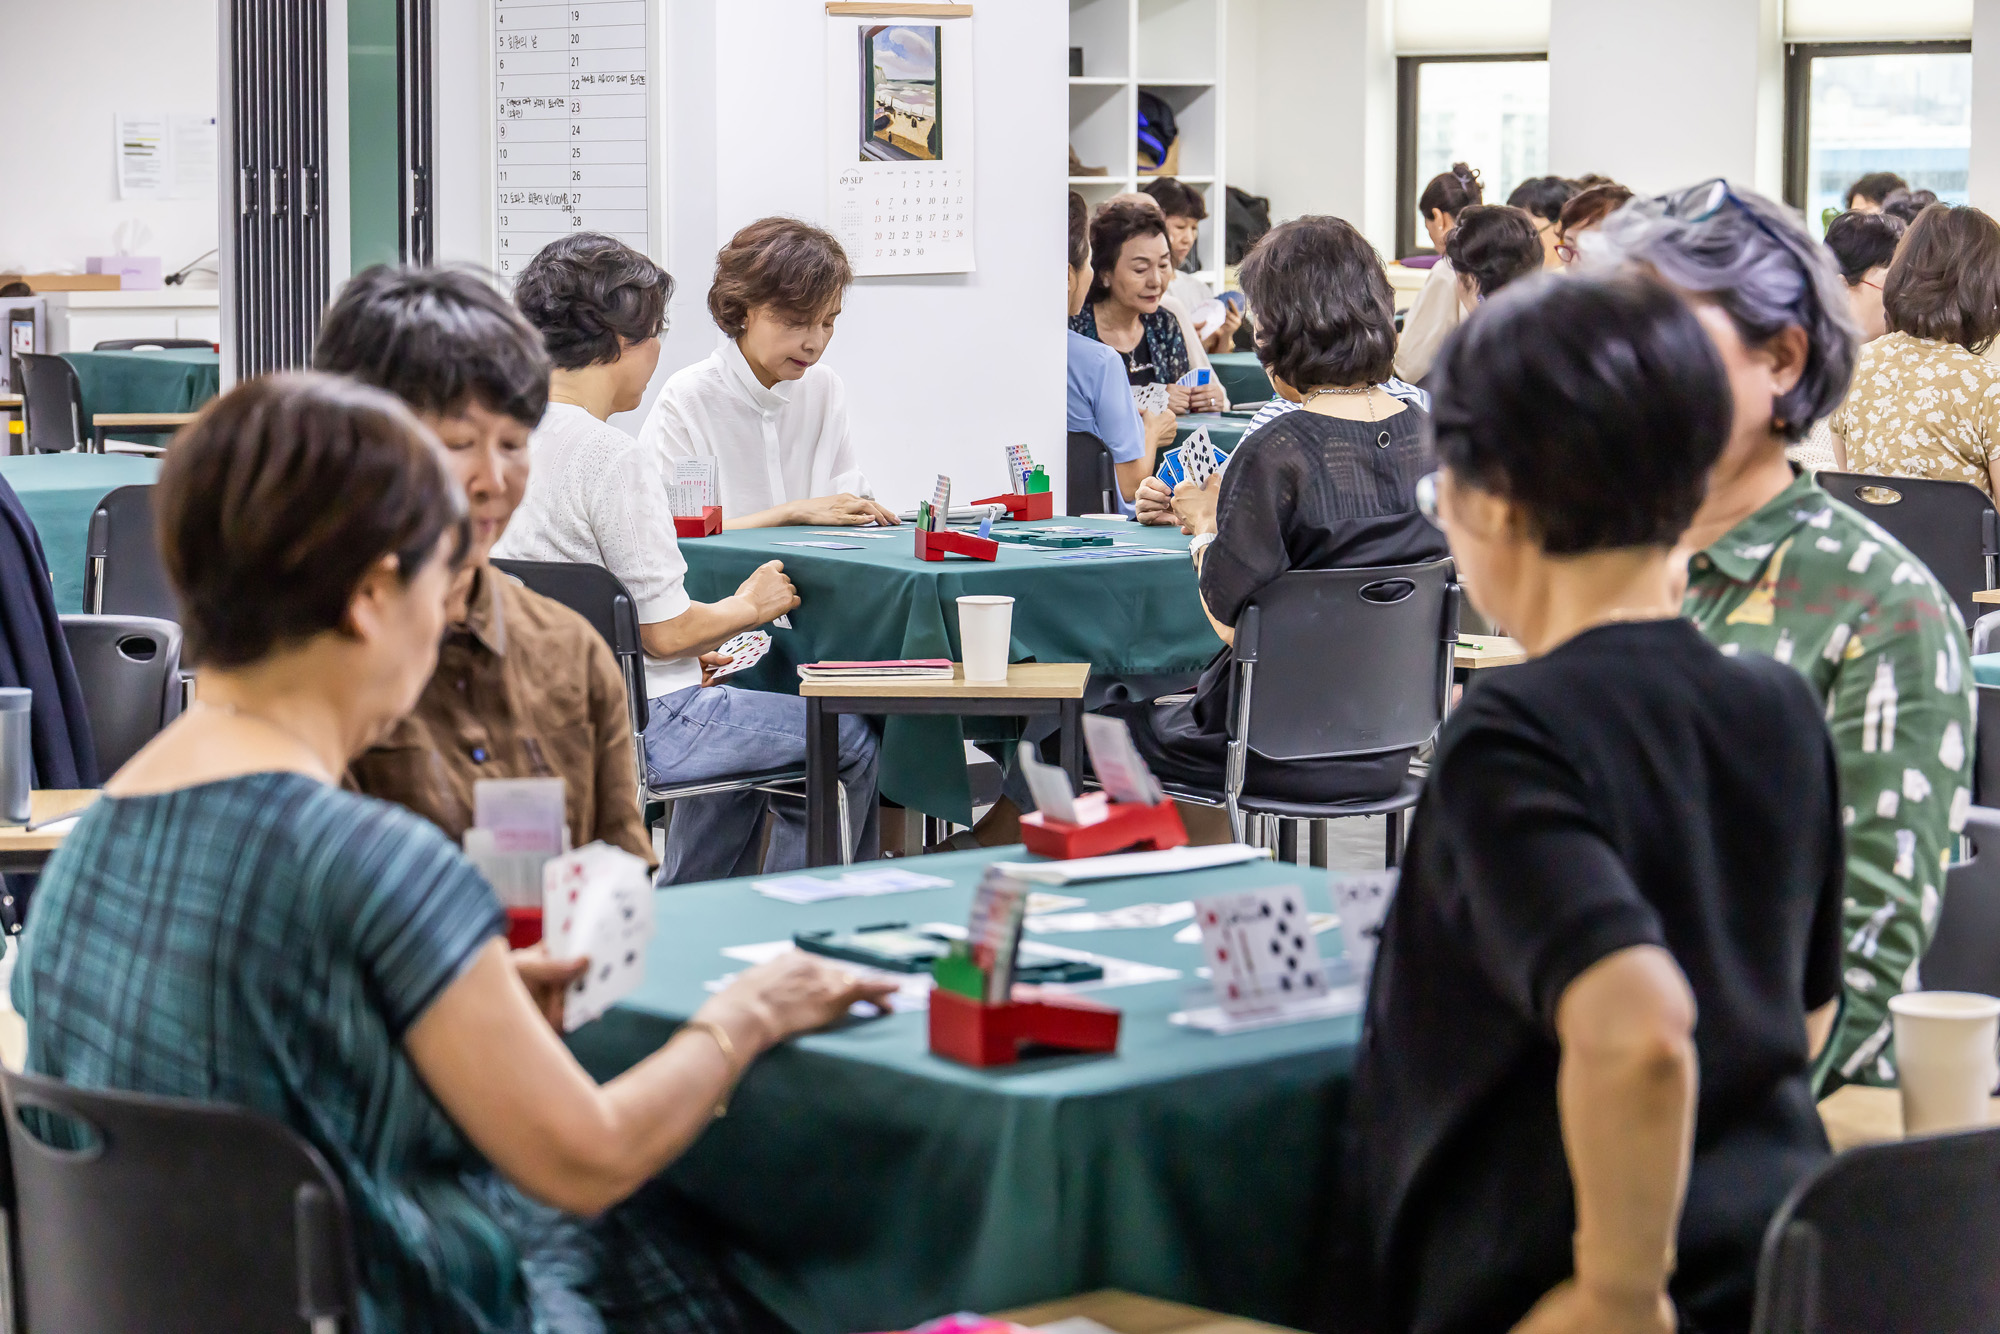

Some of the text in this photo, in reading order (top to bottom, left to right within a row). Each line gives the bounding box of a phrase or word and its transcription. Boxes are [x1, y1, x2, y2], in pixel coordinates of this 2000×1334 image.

[500, 15, 503, 23] 4
[571, 11, 579, 21] 19
[500, 37, 504, 46] 5
[508, 34, 537, 49] 회원의 날
[571, 34, 579, 43] 20
[500, 60, 504, 69] 6
[571, 57, 579, 66] 21
[500, 82, 504, 91] 7
[572, 80, 579, 89] 22
[500, 105, 504, 114] 8
[572, 103, 580, 112] 23
[501, 127, 505, 136] 9
[572, 126, 580, 135] 24
[500, 149, 507, 158] 10
[572, 149, 580, 157] 25
[500, 172, 507, 180] 11
[572, 171, 581, 180] 26
[840, 177, 848, 185] 09
[916, 180, 920, 188] 2
[500, 194, 507, 203] 12
[528, 192, 543, 205] 회원의
[573, 194, 581, 203] 27
[916, 197, 920, 205] 9
[929, 197, 935, 205] 10
[956, 196, 963, 204] 12
[500, 217, 508, 225] 13
[573, 217, 581, 226] 28
[943, 213, 949, 221] 18
[875, 232, 882, 240] 20
[888, 232, 895, 240] 21
[902, 231, 909, 239] 22
[916, 231, 922, 239] 23
[943, 230, 949, 238] 25
[956, 230, 963, 238] 26
[501, 239, 508, 247] 14
[875, 249, 882, 257] 27
[903, 248, 910, 256] 29
[501, 261, 508, 270] 15
